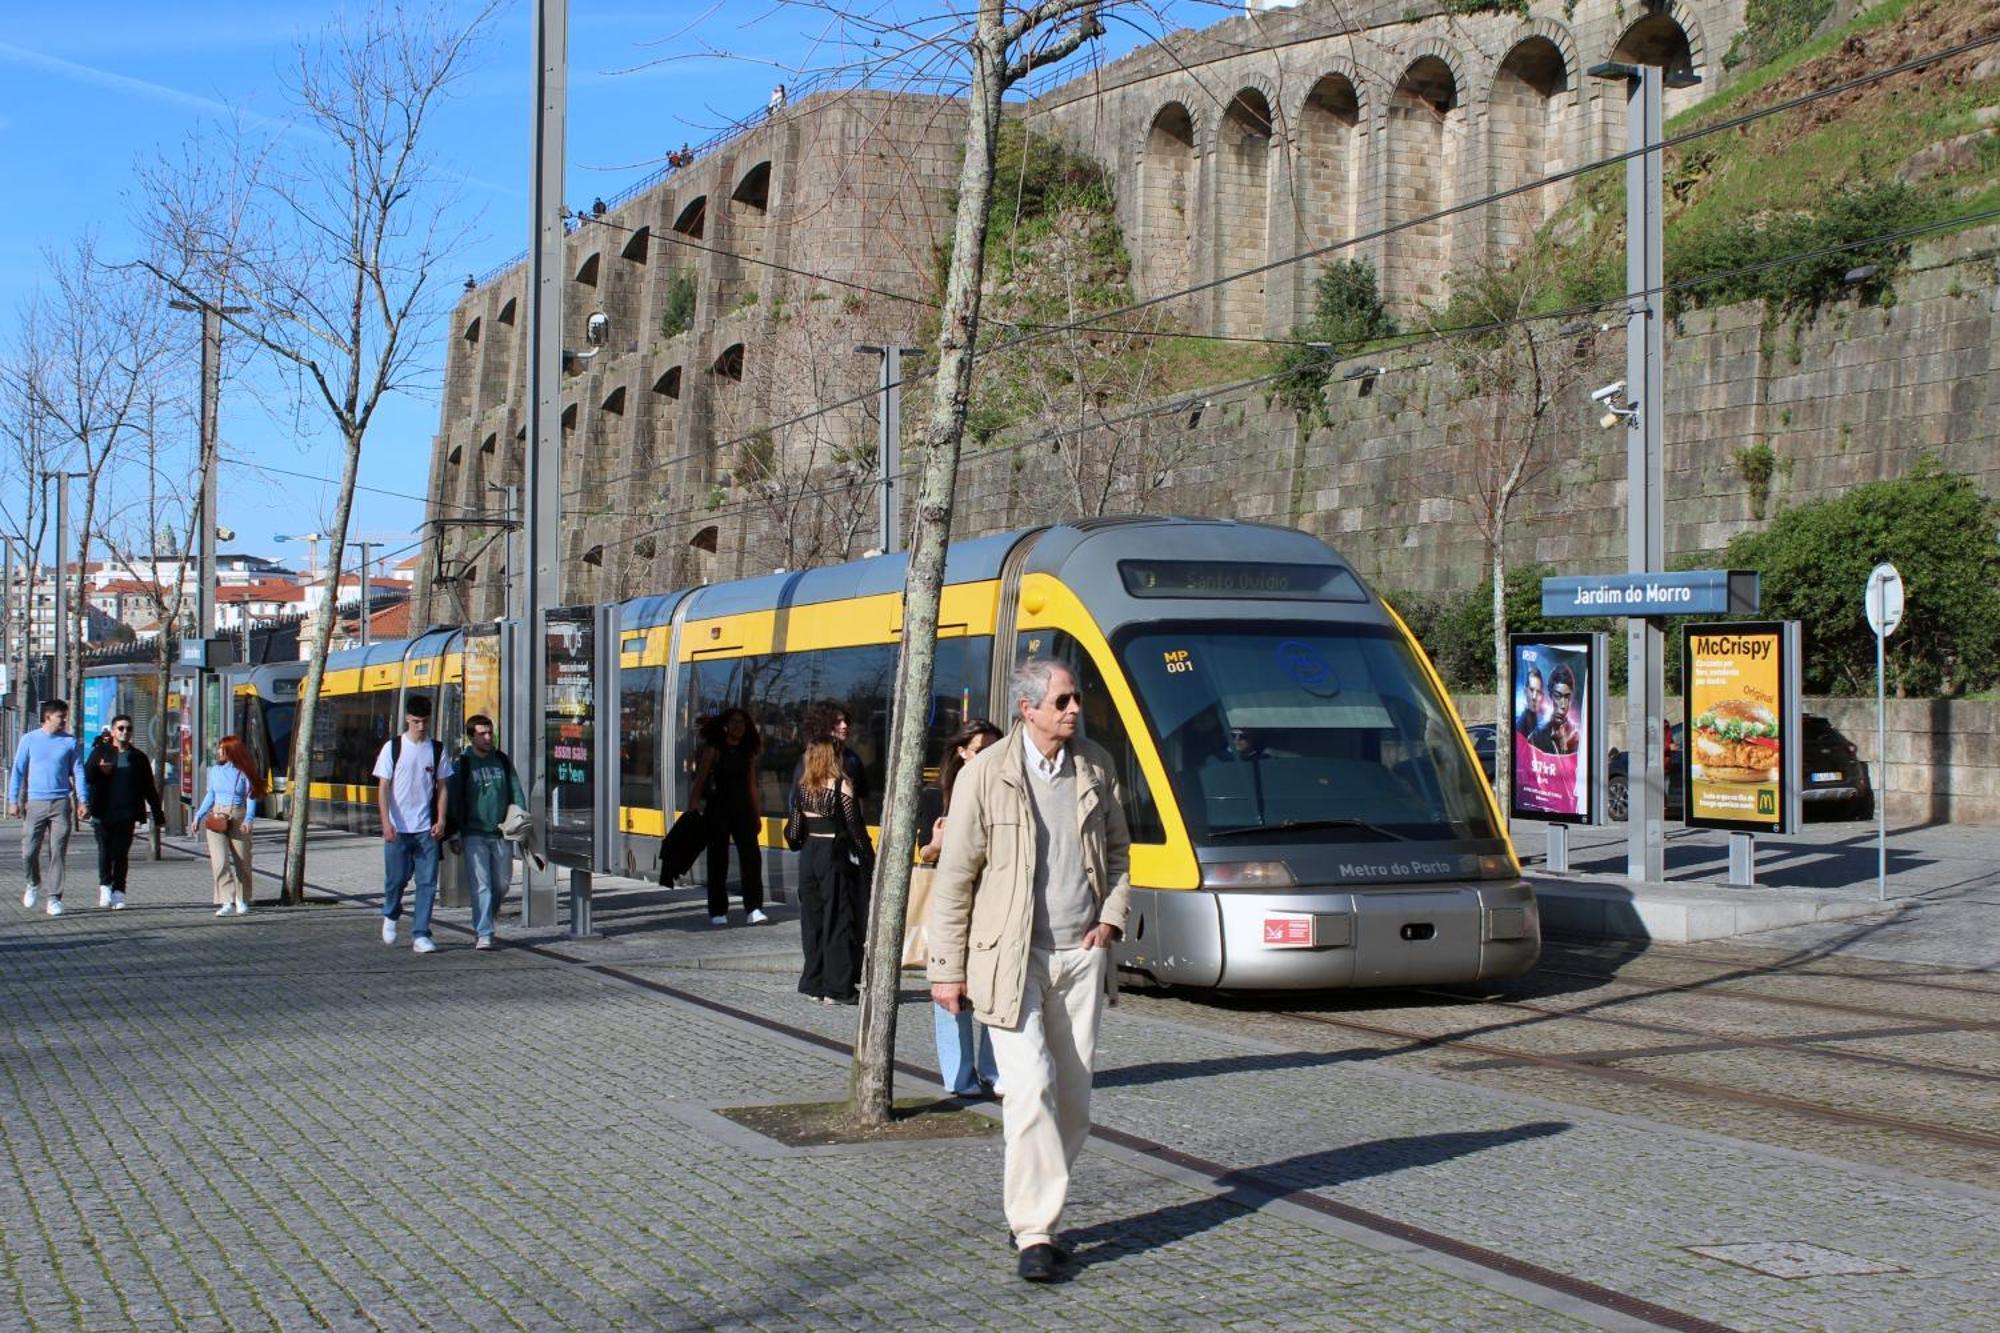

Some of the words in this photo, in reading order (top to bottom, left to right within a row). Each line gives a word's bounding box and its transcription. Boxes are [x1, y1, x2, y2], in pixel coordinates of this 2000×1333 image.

[1574, 585, 1622, 605] Jardim
[1625, 585, 1642, 603] do
[1646, 583, 1691, 602] Morro
[1163, 650, 1189, 663] MP
[1697, 636, 1771, 660] McCrispy
[1167, 660, 1193, 673] 001
[1339, 863, 1388, 877] Metro
[1391, 862, 1410, 875] do
[1410, 860, 1450, 874] Porto
